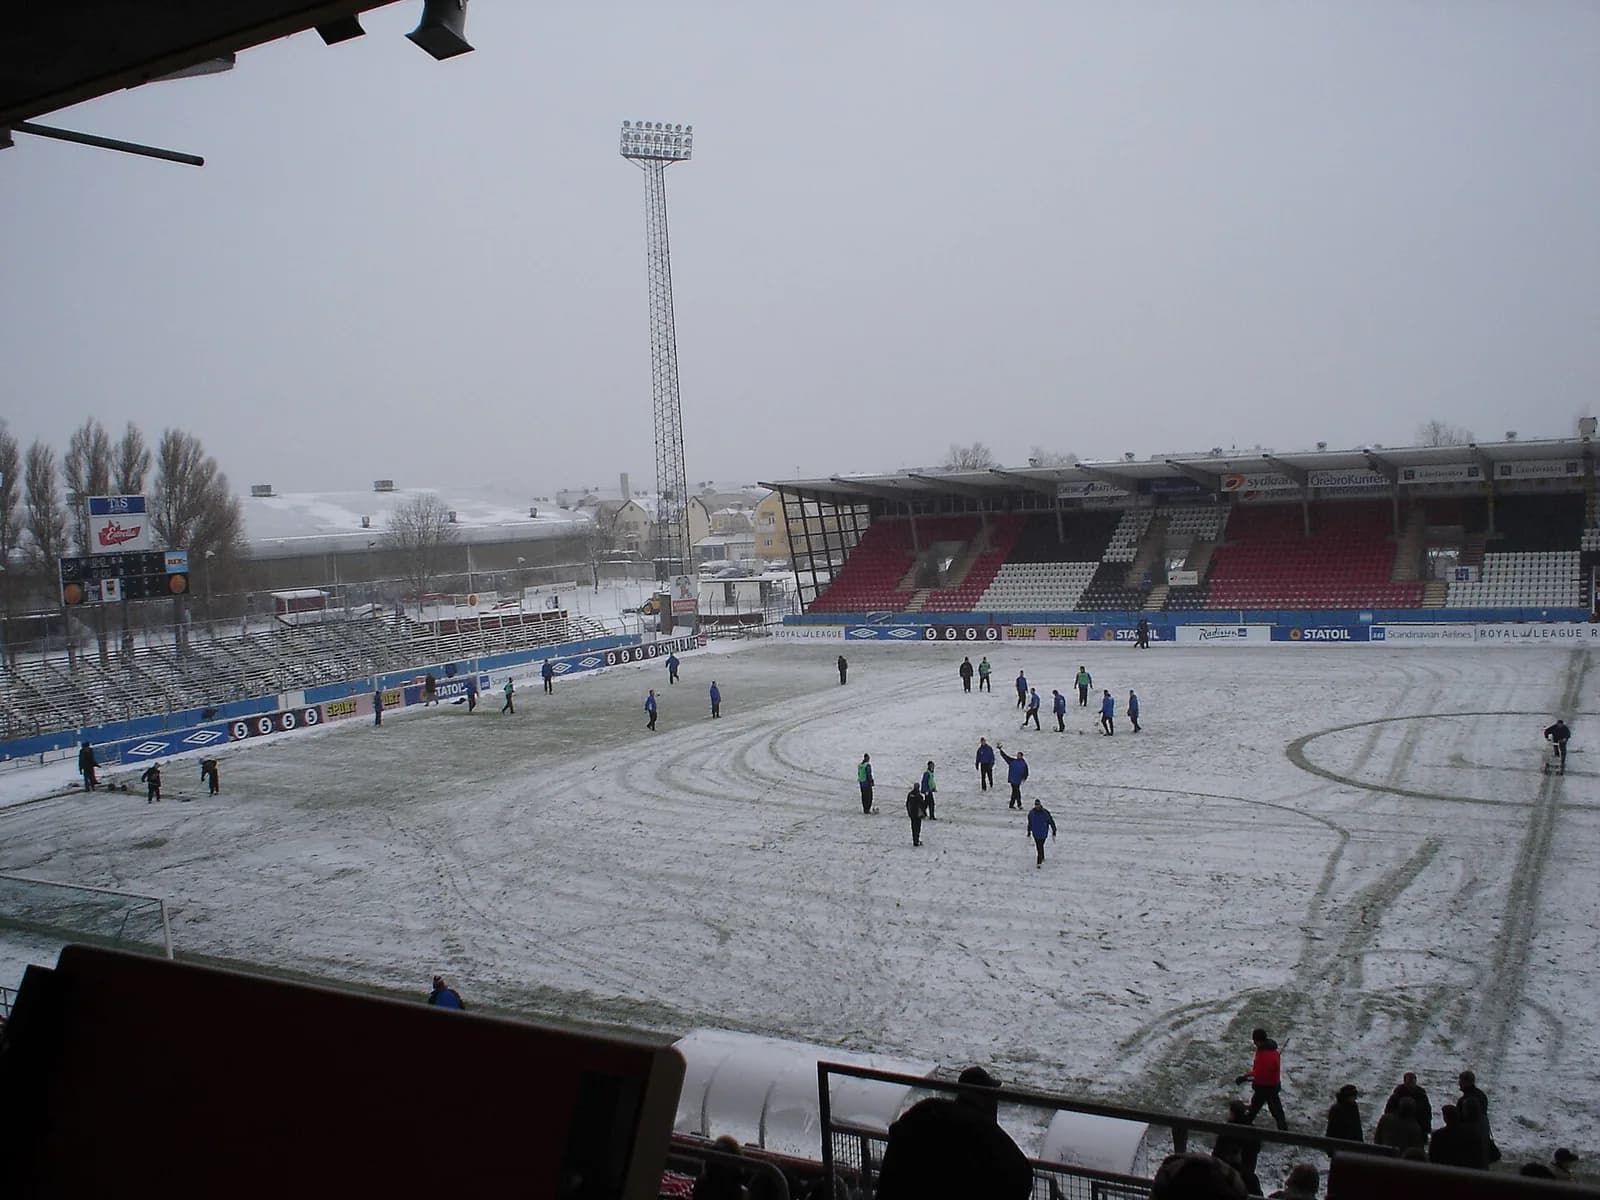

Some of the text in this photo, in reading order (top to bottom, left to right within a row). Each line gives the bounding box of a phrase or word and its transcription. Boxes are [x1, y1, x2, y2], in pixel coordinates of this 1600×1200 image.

[775, 630, 843, 638] ROYAL LEAGUE
[1116, 629, 1160, 639] STAIL
[1303, 629, 1351, 639] STATOIL
[1480, 629, 1518, 637] ROYAL
[1533, 629, 1582, 637] LEAGUE
